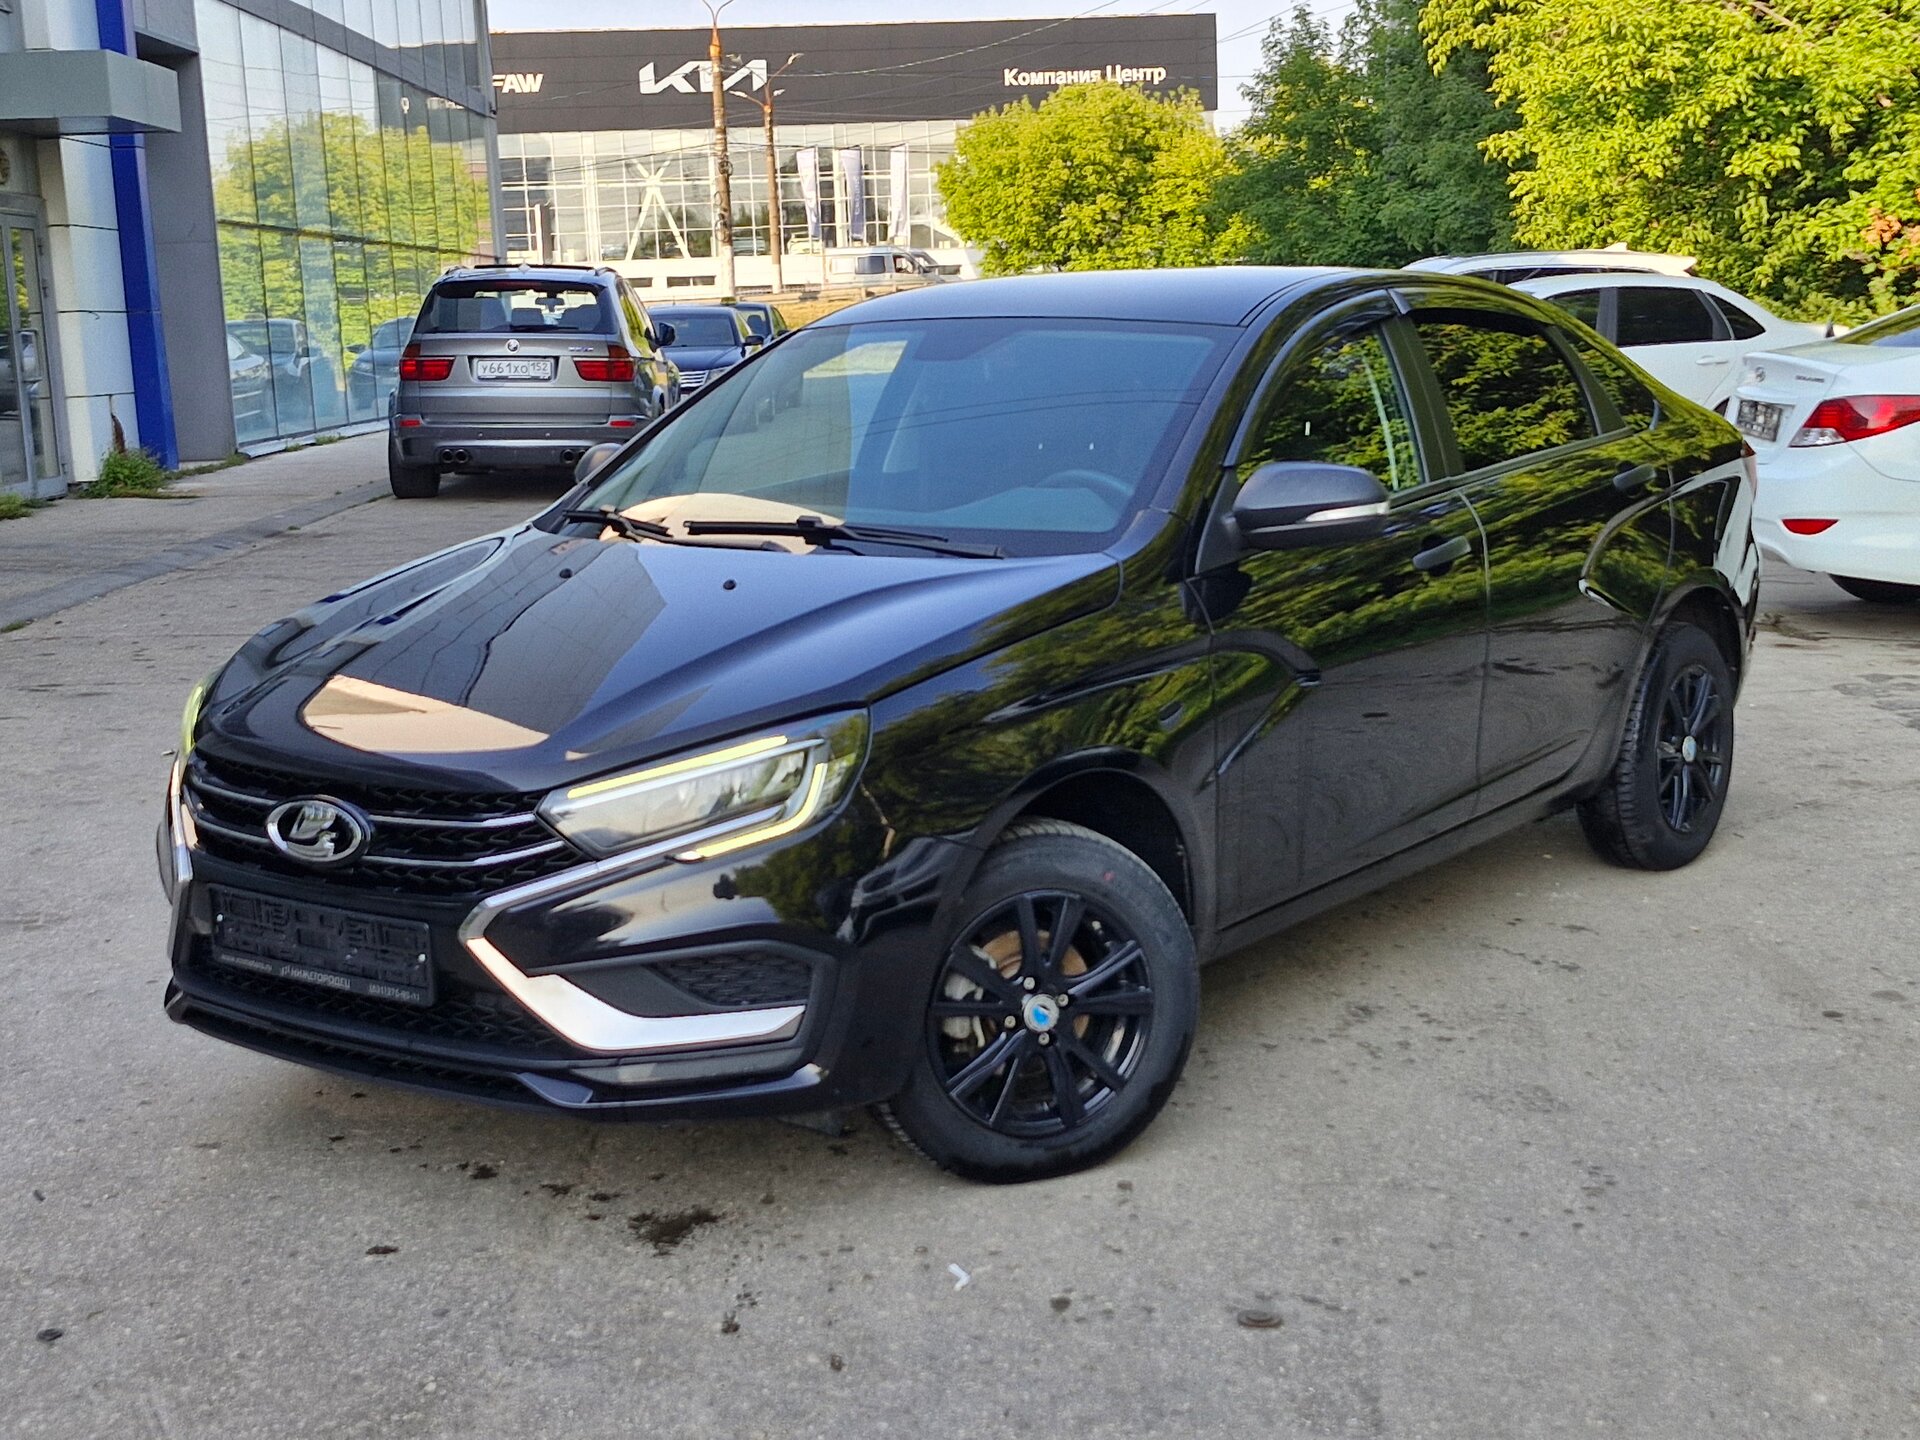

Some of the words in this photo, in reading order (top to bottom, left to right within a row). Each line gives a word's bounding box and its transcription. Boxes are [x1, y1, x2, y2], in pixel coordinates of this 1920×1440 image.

[492, 73, 544, 94] FAW
[638, 59, 768, 94] KIA
[1003, 68, 1102, 87] Компания
[1105, 64, 1167, 85] Центр
[530, 362, 549, 372] 152
